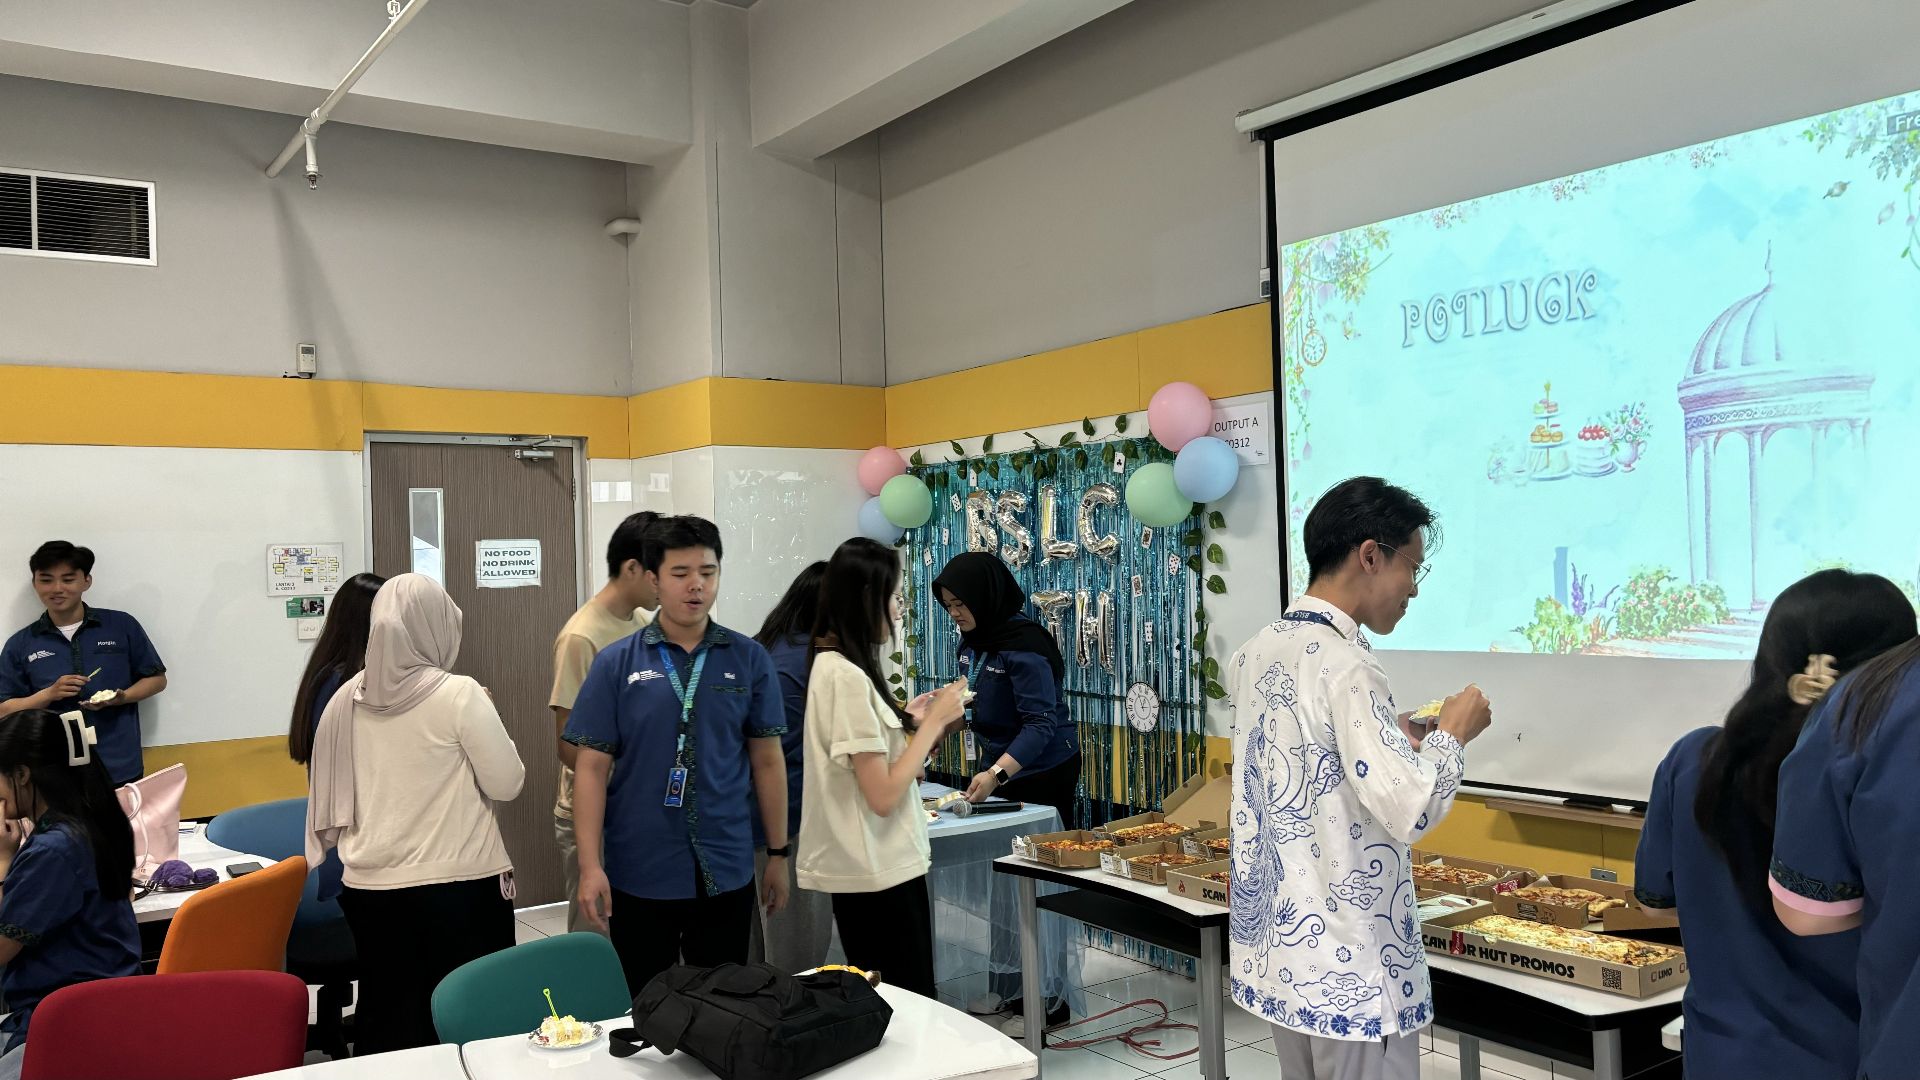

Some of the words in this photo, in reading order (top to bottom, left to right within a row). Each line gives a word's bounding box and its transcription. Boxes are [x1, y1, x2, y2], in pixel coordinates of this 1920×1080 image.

[1400, 268, 1598, 349] POTLUCK
[1214, 417, 1250, 432] OUTPUT
[1252, 416, 1259, 427] A
[1225, 437, 1250, 449] 0312
[499, 559, 535, 567] DRINK
[482, 569, 536, 577] ALLOWED
[1202, 887, 1226, 902] SCAN
[1421, 934, 1447, 951] CAN
[1479, 946, 1508, 963] HUT
[1510, 953, 1575, 979] PROMOS
[1658, 967, 1673, 980] LIMO
